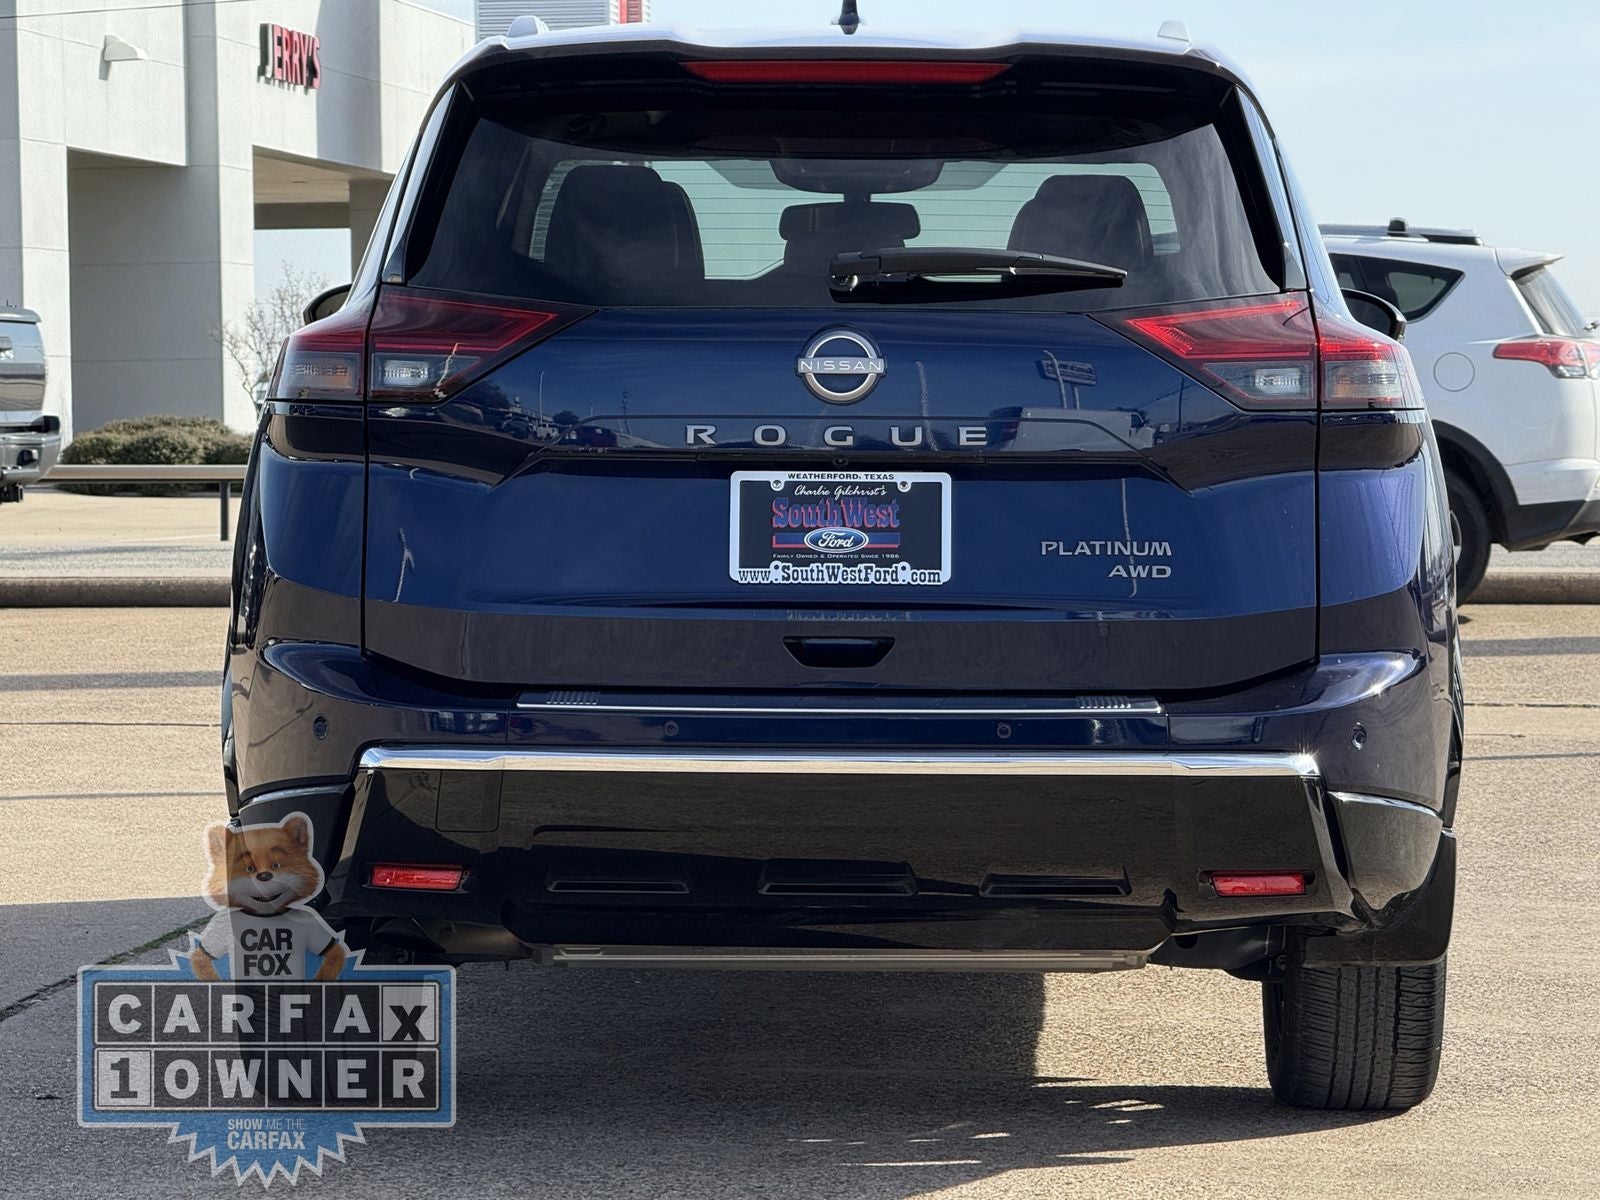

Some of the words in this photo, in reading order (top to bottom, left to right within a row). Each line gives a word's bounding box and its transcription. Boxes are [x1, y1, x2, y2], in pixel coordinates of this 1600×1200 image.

[258, 23, 321, 89] JERRY'S
[800, 360, 883, 371] NISSAN
[686, 425, 988, 446] ROGUE
[794, 484, 831, 496] Charlie
[833, 485, 887, 501] Gilchrist's
[772, 498, 900, 528] SouthWest
[818, 532, 854, 549] Ford
[1041, 541, 1172, 556] PLATINUM
[738, 564, 941, 583] www.SouthWestFord.com
[1108, 565, 1171, 578] AWD
